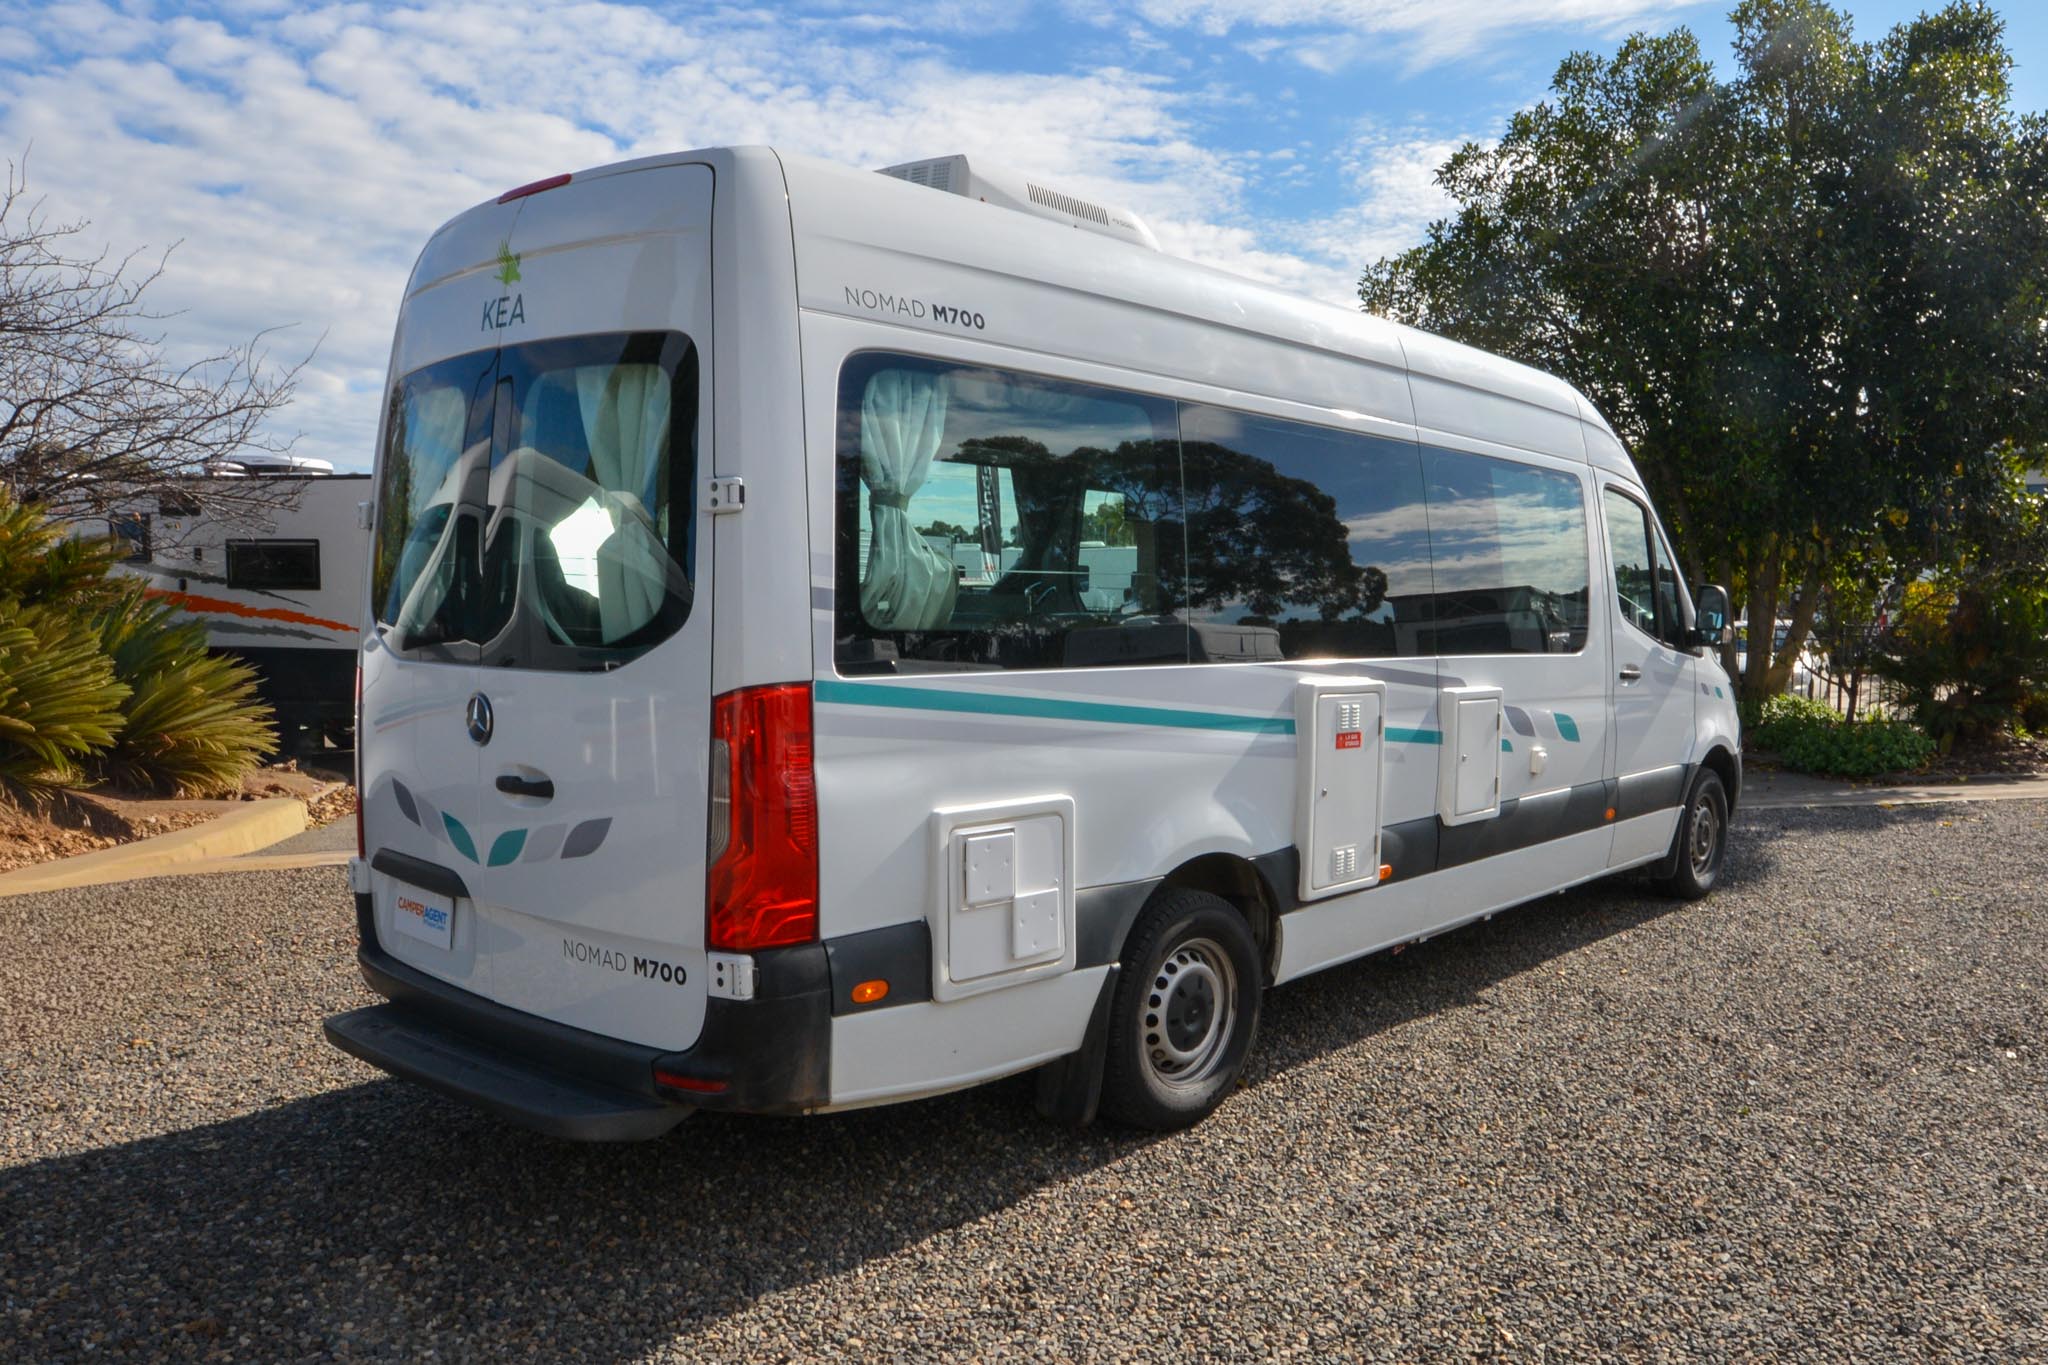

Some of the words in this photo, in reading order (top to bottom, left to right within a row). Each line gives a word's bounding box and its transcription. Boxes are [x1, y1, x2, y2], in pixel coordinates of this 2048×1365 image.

[481, 293, 525, 331] KEA
[844, 286, 926, 318] NOMAD
[932, 304, 985, 330] M700
[563, 938, 627, 972] NOMAD
[633, 956, 687, 986] M700
